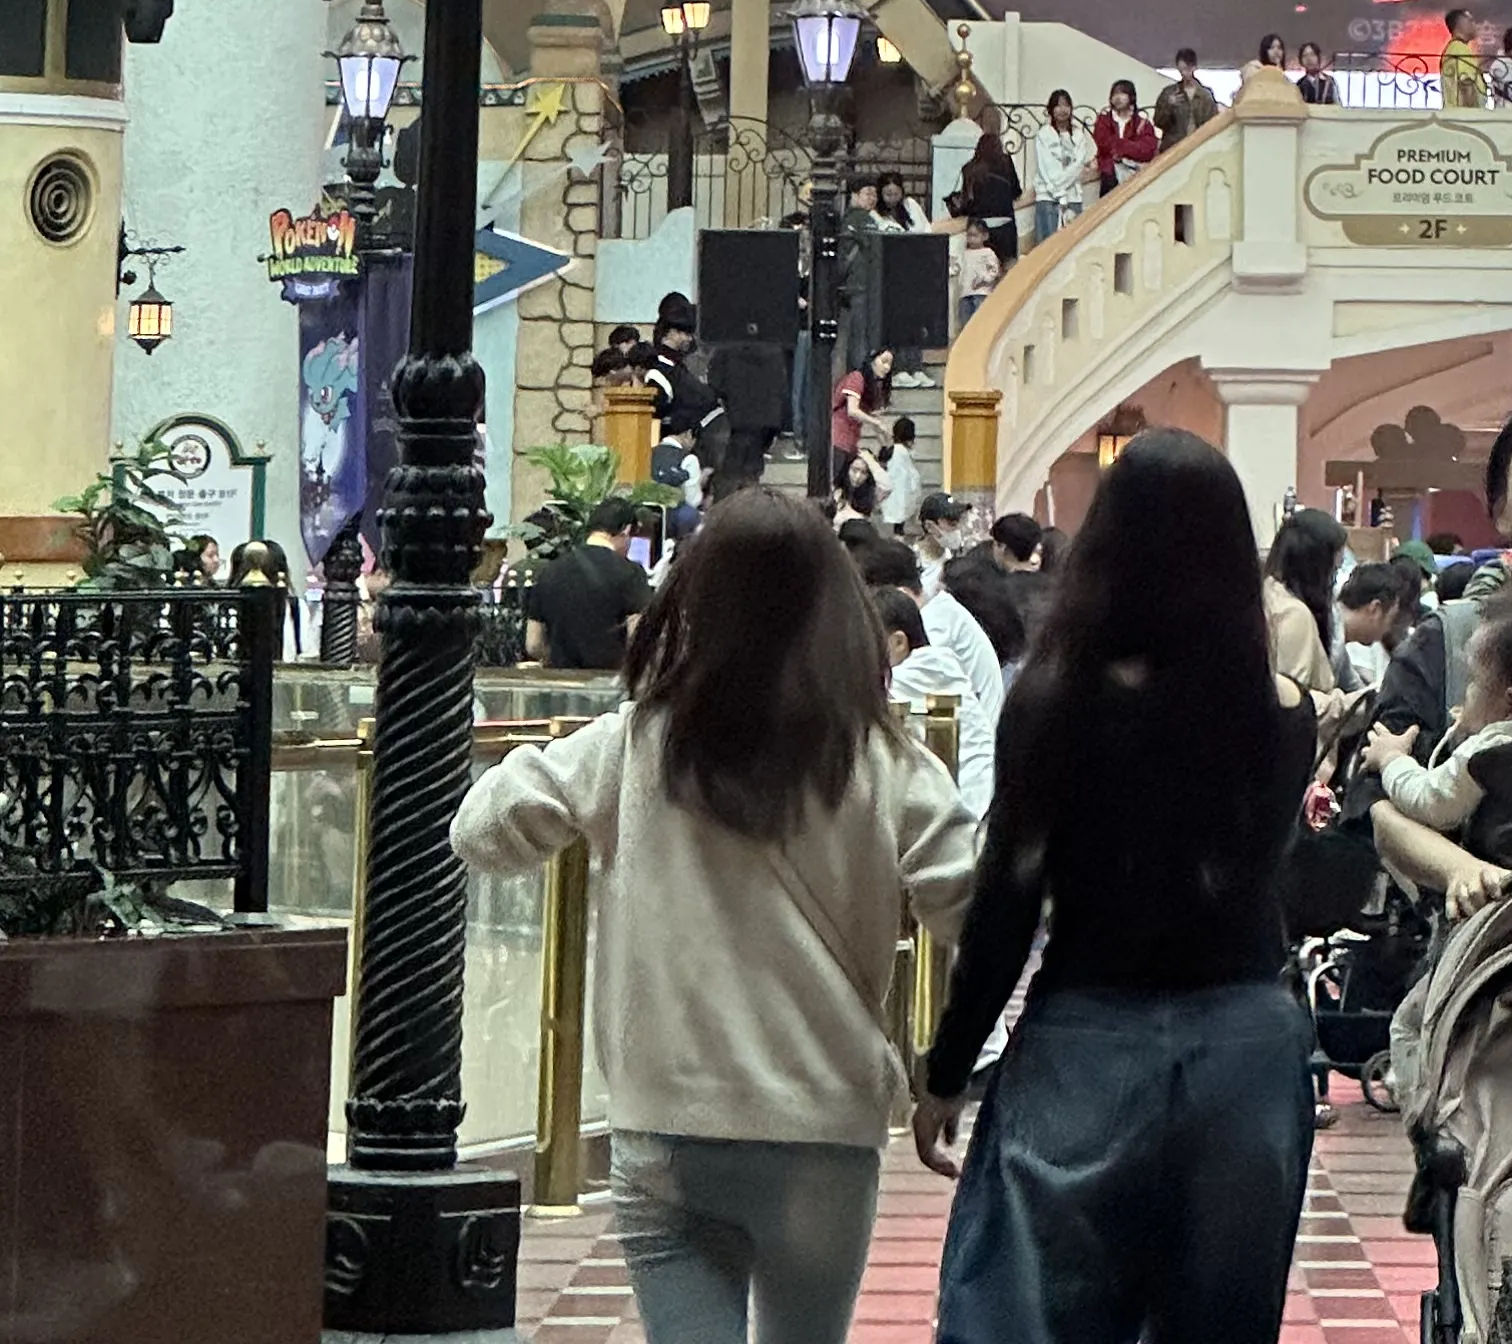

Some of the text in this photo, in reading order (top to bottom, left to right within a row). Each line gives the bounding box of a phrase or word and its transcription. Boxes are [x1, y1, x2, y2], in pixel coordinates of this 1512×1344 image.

[1396, 149, 1471, 163] PREMIUM
[1367, 168, 1500, 186] FOOD COURT
[1418, 219, 1448, 239] 2F
